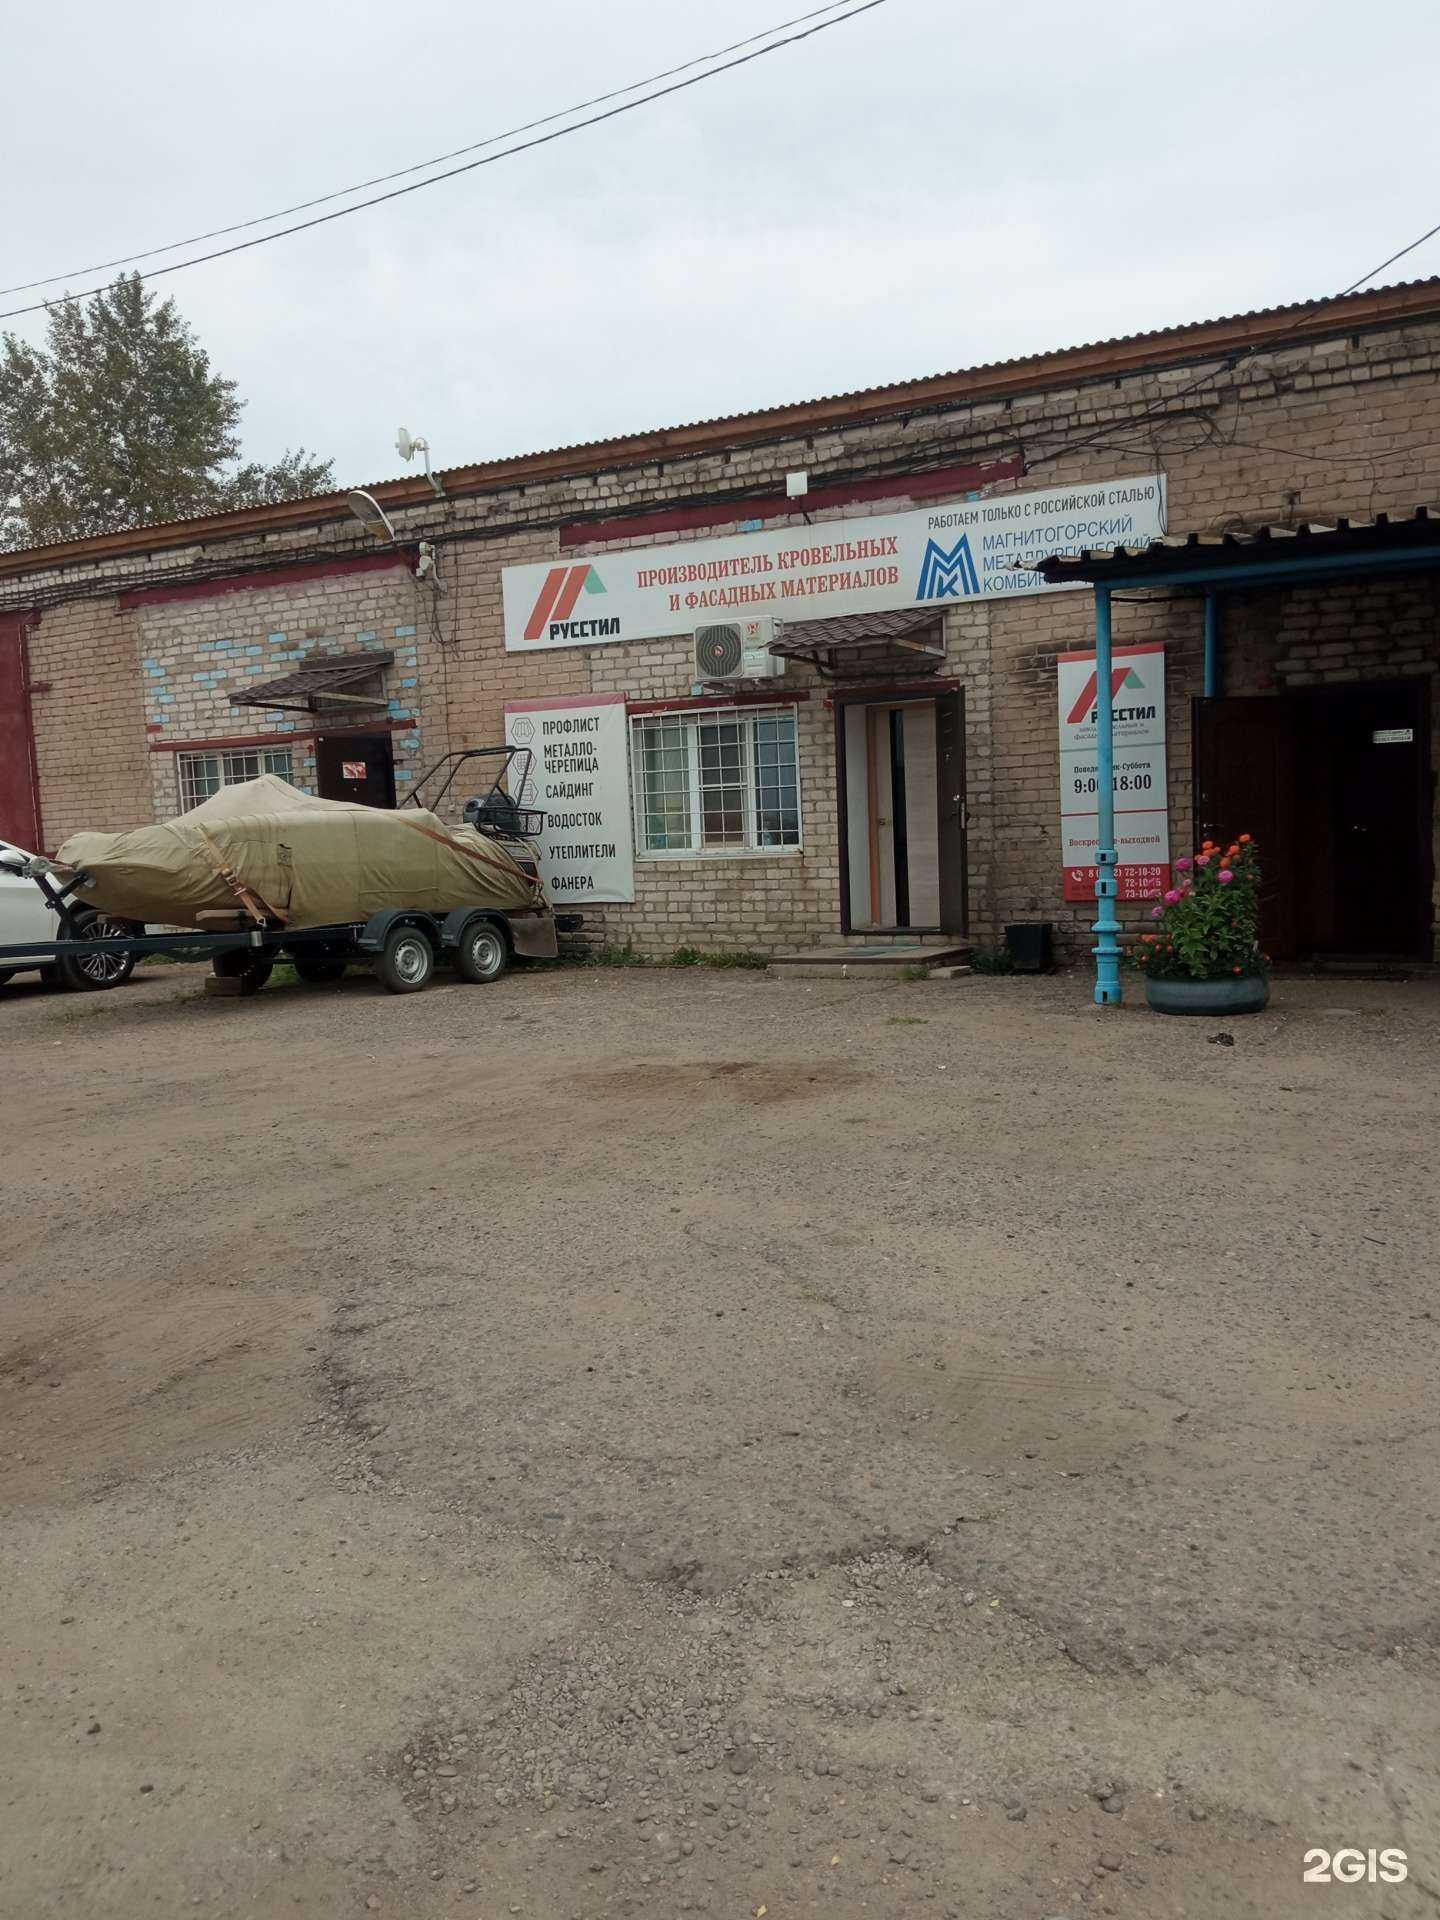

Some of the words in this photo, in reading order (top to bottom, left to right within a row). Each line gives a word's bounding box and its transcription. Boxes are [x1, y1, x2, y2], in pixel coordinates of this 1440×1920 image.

[928, 511, 979, 530] РАБОТАЕМ
[981, 505, 1021, 523] ТОЛЬКО
[1024, 504, 1031, 517] С
[1034, 491, 1105, 515] РОССИЙСКОЙ
[1109, 486, 1155, 505] СТАЛЬЮ
[983, 514, 1133, 551] МАГНИТОГОРСКИЙ
[637, 554, 774, 589] ПРОИЗВОДИТЕЛЬ
[777, 536, 899, 570] КРОВЕЛЬНЫХ
[669, 594, 681, 612] И
[685, 580, 776, 609] ФАСАДНЫХ
[780, 566, 899, 598] МАТЕРИАЛОВ
[550, 617, 620, 640] РУССТИЛ
[1091, 706, 1155, 724] РССТИЛ
[542, 717, 600, 736] ПРОФЛИСТ
[544, 741, 597, 759] МЕТАЛЛО-
[544, 757, 599, 774] ЧЕРЕПИЦА
[545, 782, 594, 799] САЙДИНГ
[547, 812, 602, 829] ВОДОСТОК
[549, 844, 616, 860] УТЕПЛИТЕЛИ
[1124, 867, 1161, 877] 72-10-20
[551, 876, 594, 890] ФАНЕРА
